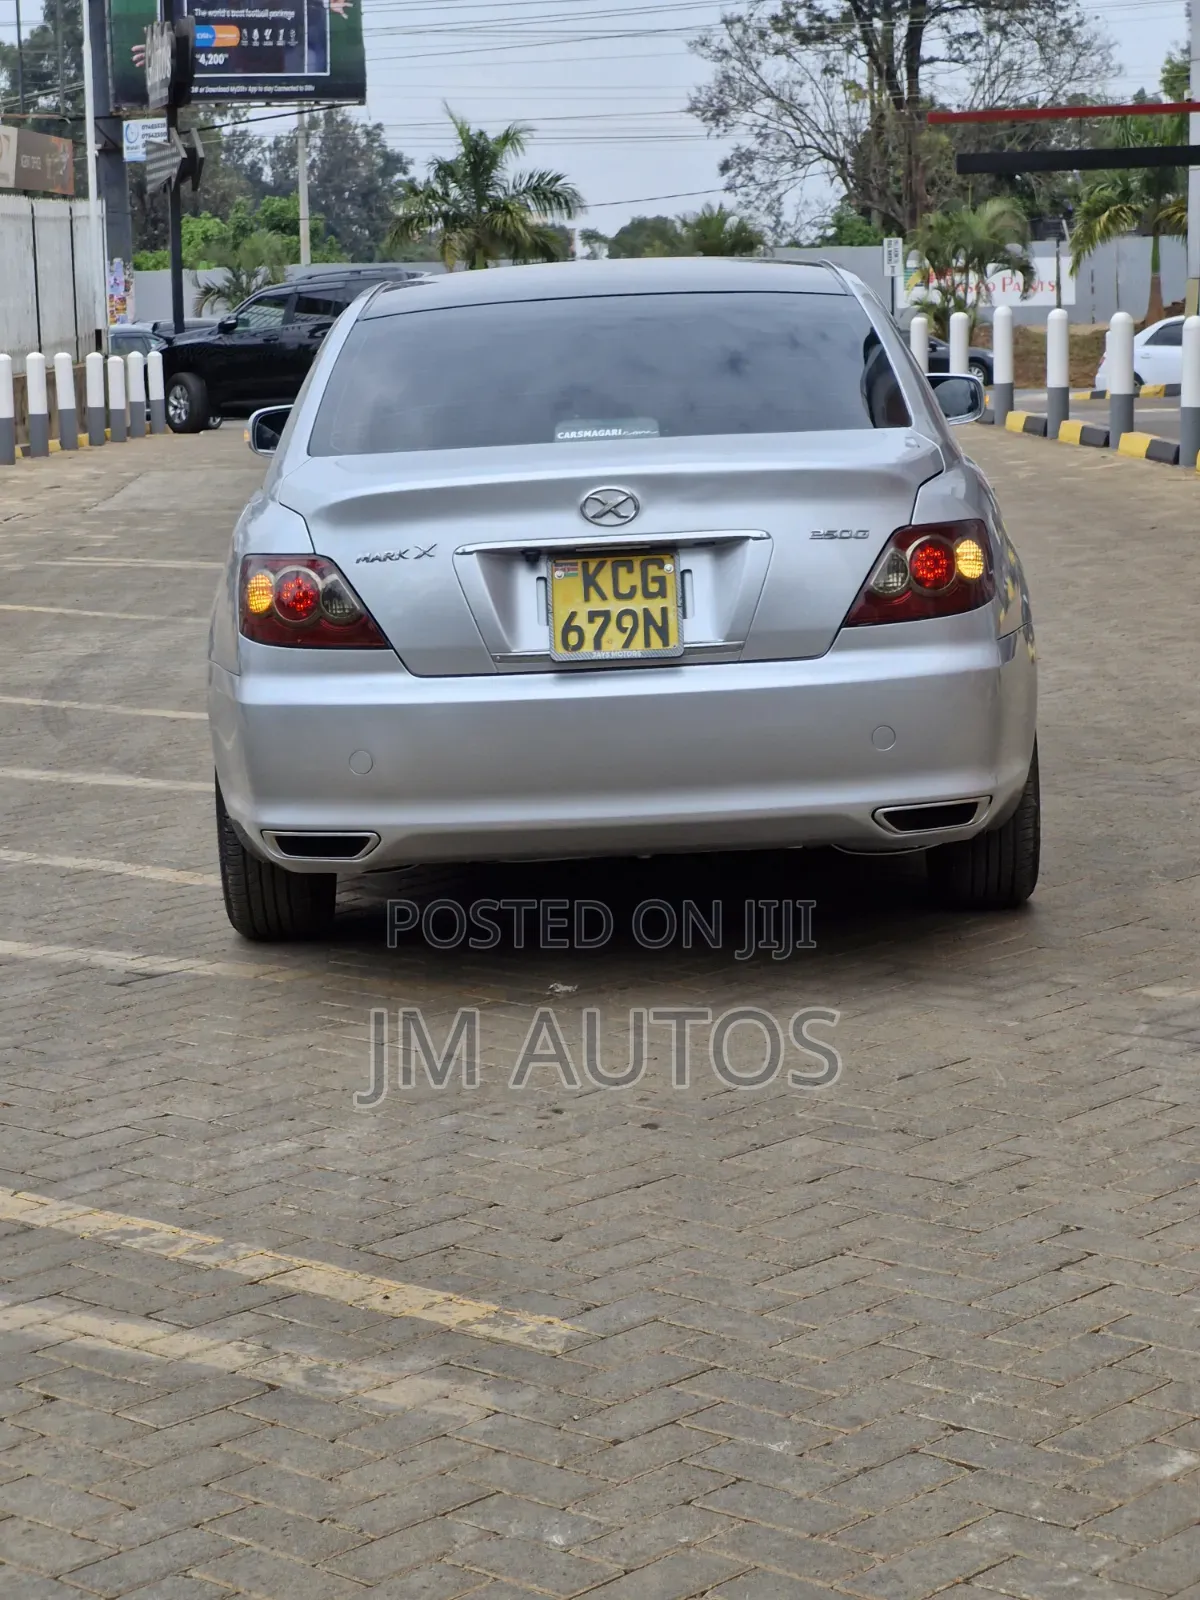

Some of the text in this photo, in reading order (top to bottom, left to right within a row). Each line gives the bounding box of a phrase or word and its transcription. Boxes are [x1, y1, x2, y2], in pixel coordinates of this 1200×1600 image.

[193, 8, 207, 17] The
[246, 8, 269, 18] football
[269, 10, 295, 20] package
[356, 543, 438, 564] MARK X
[581, 557, 668, 603] KCG
[561, 606, 670, 652] 679N
